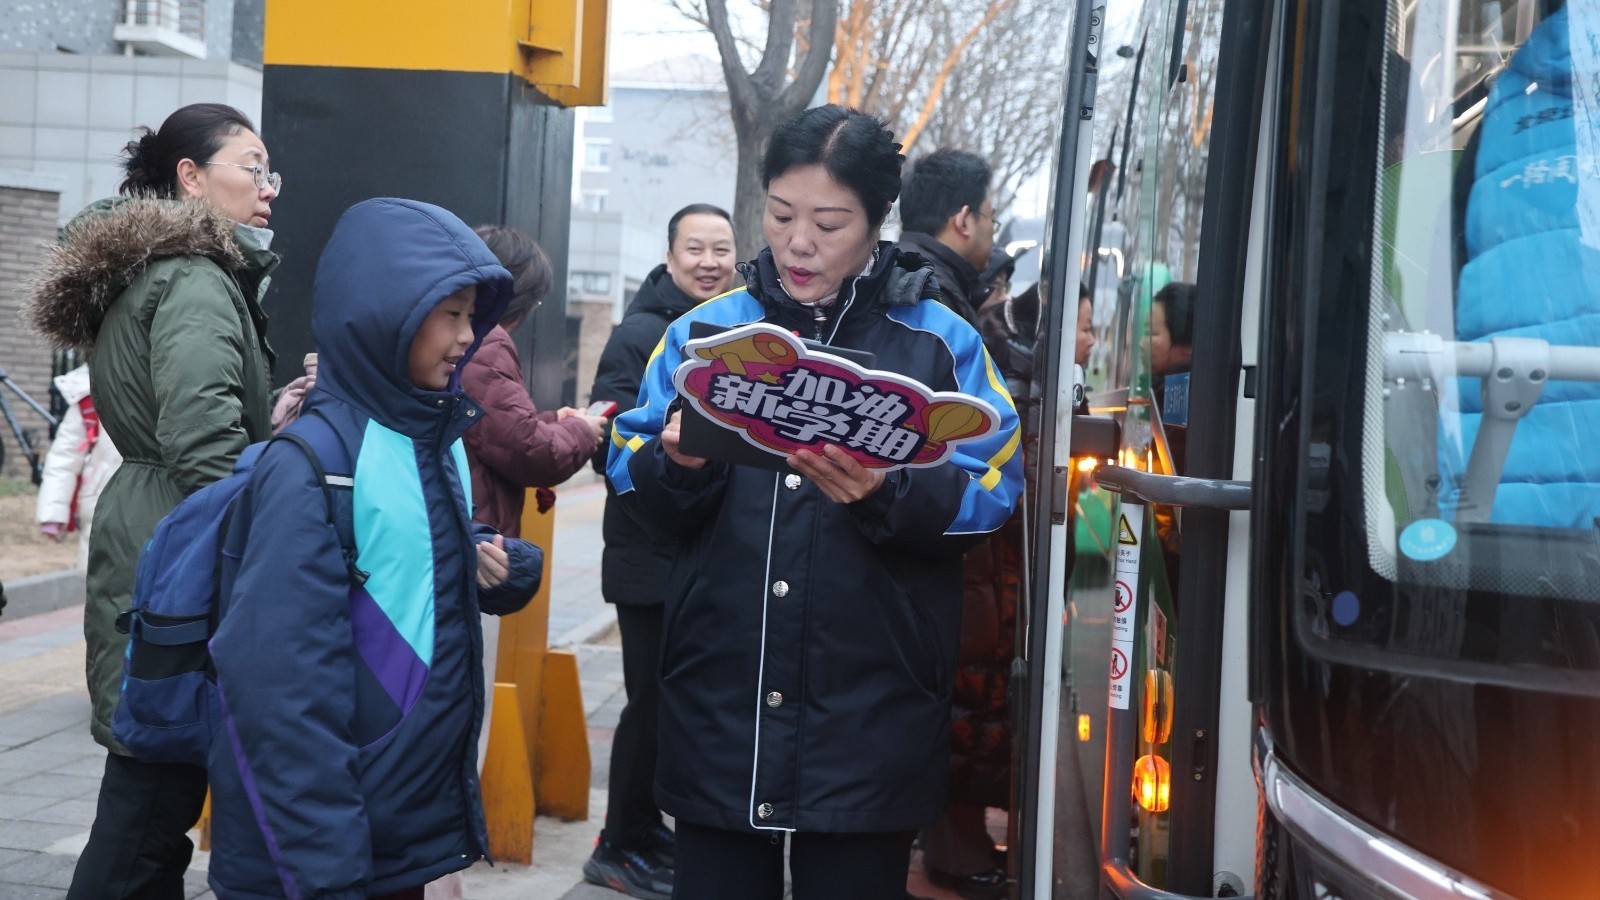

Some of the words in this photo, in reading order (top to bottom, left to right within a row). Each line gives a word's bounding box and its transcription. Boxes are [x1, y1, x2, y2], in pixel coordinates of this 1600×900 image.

[710, 374, 920, 461] 新学期
[783, 369, 908, 424] 加油
